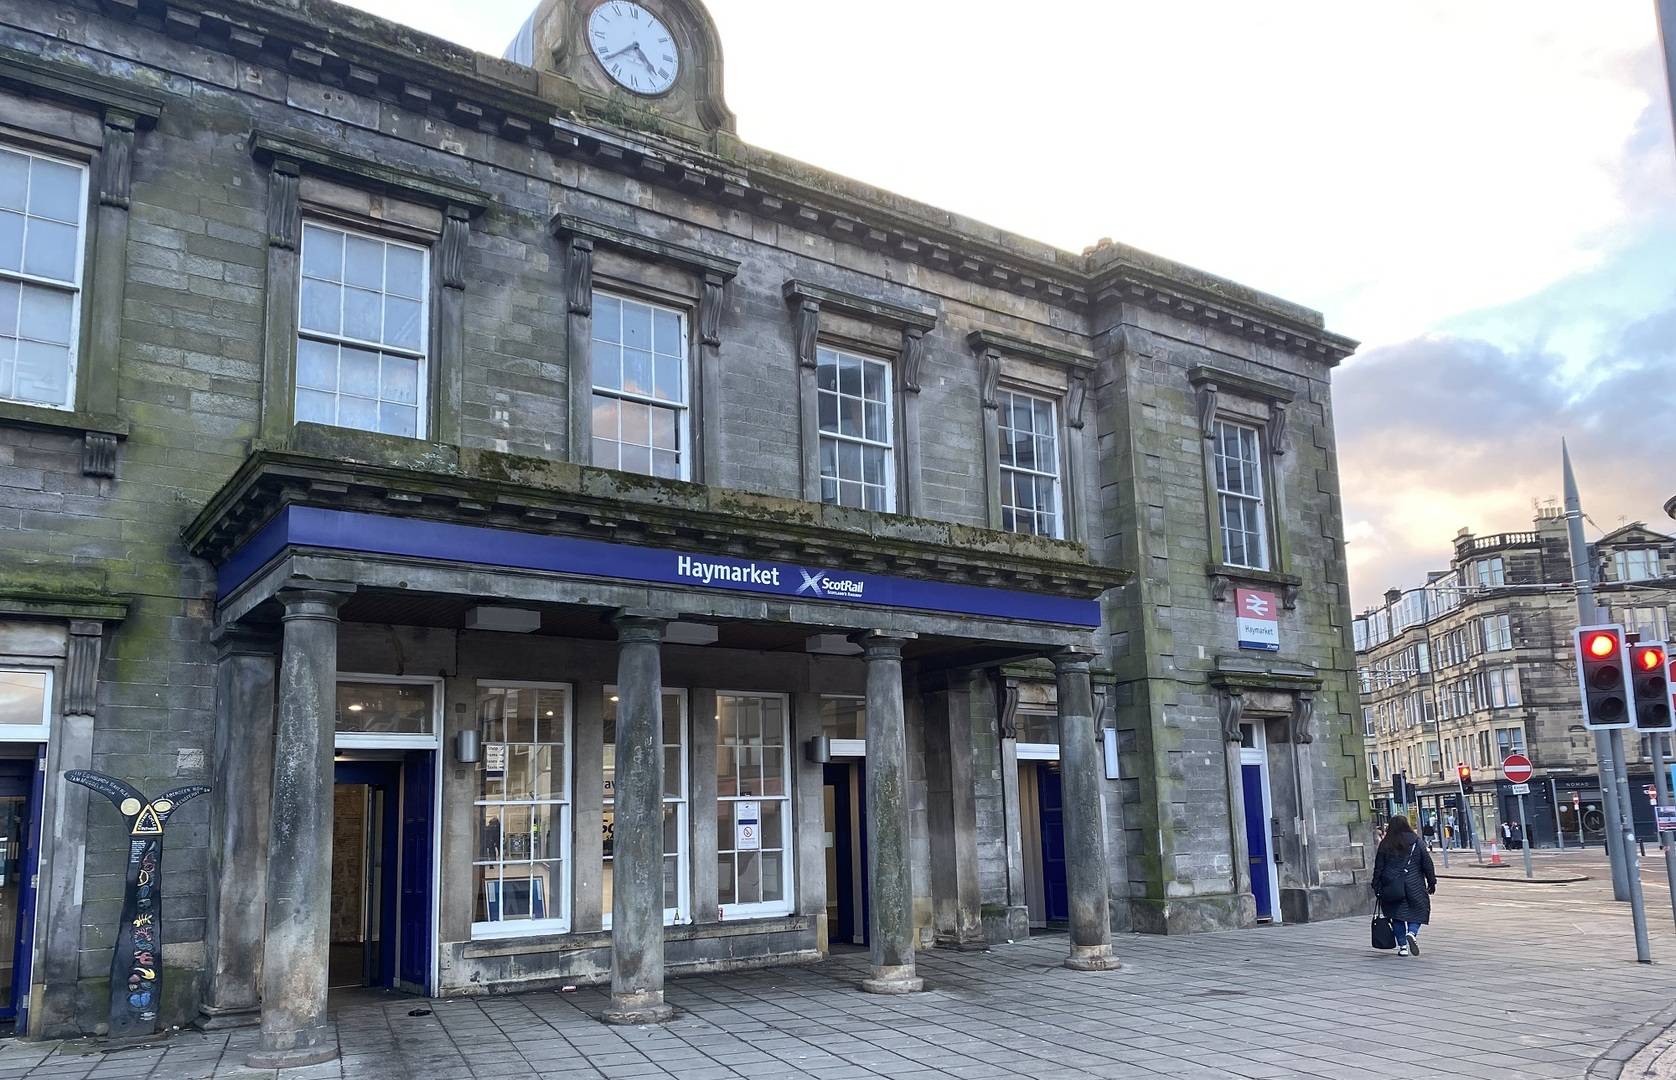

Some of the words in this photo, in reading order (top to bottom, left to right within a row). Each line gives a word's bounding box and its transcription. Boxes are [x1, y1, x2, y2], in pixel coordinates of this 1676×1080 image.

[678, 555, 780, 586] Haymarket
[822, 577, 864, 594] ScotRail
[1245, 625, 1273, 636] Haymarket
